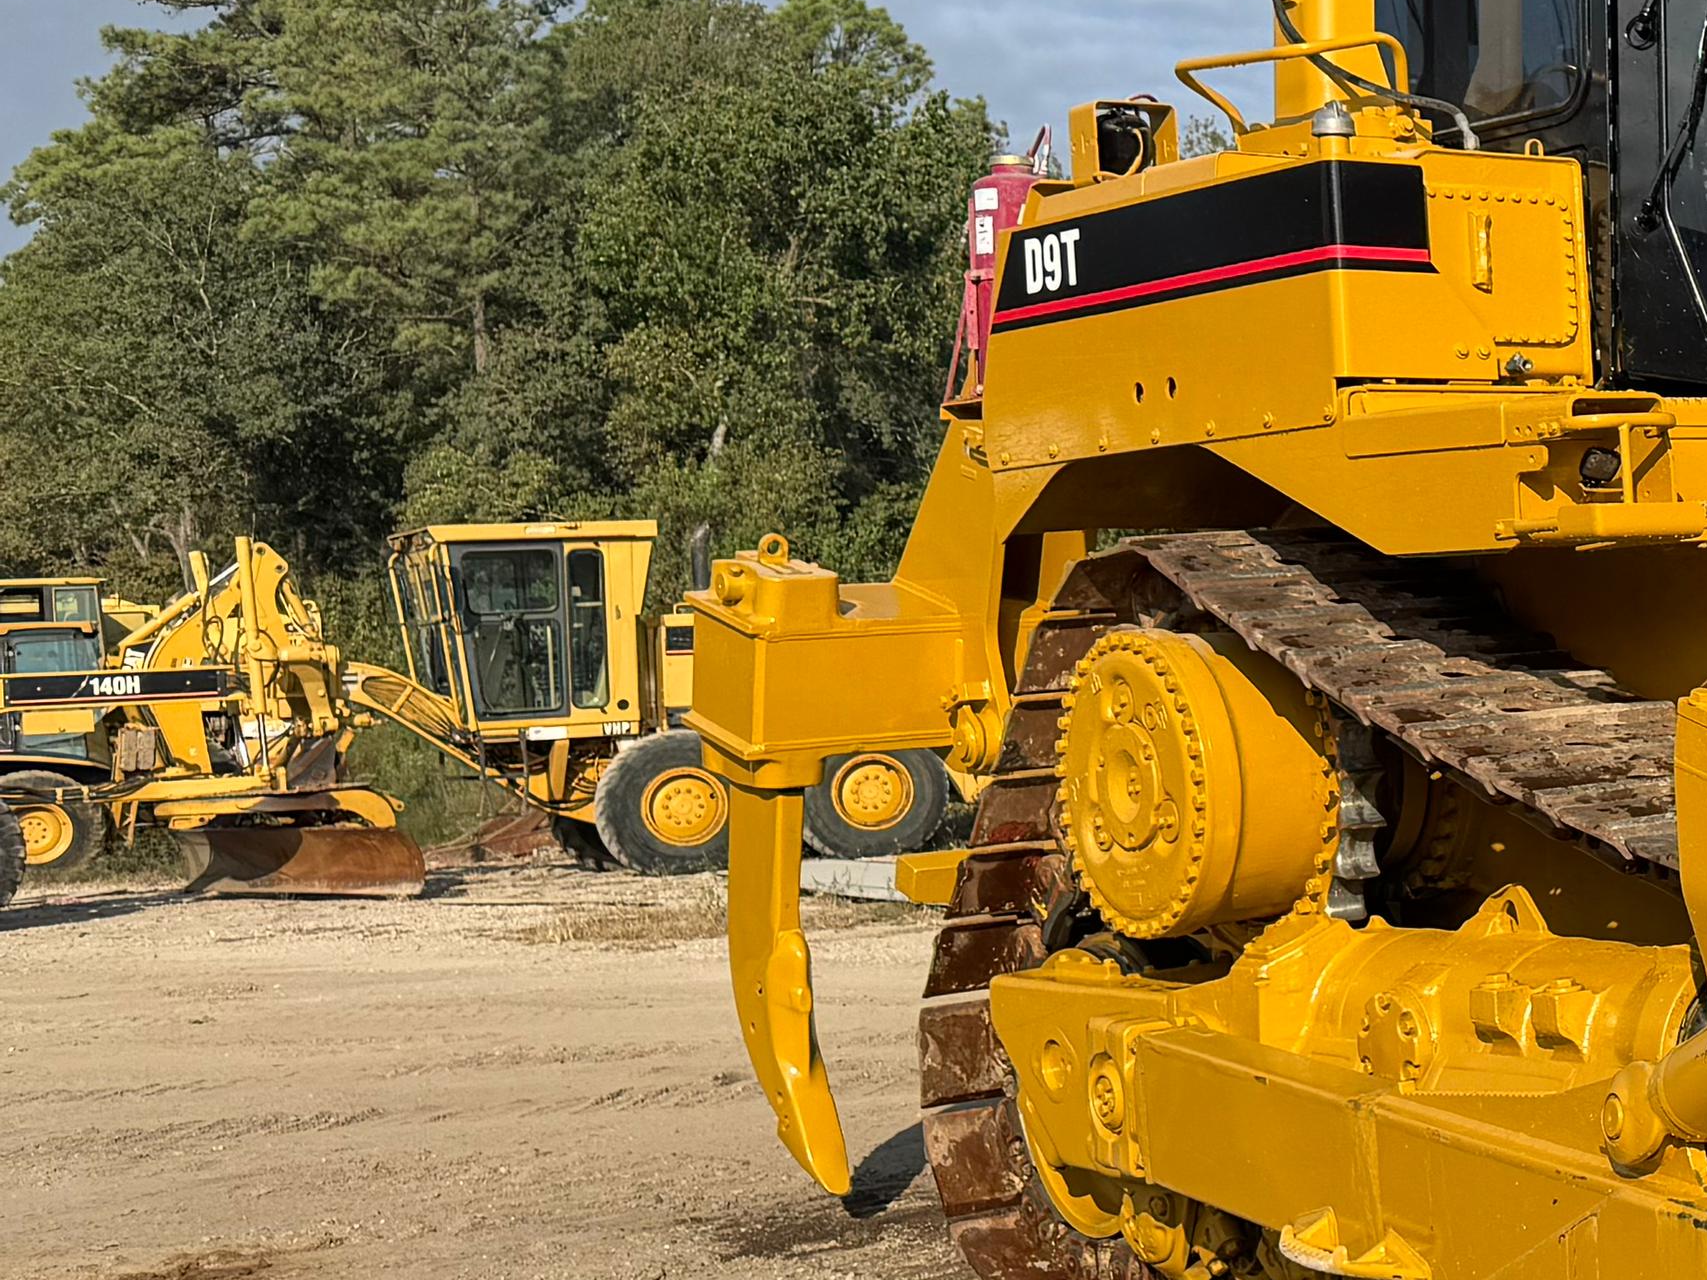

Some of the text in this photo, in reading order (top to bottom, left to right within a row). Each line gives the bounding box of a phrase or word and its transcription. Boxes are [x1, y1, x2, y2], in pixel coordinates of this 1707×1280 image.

[1024, 228, 1080, 295] D9T
[89, 675, 141, 696] 140H
[603, 722, 632, 735] VHP
